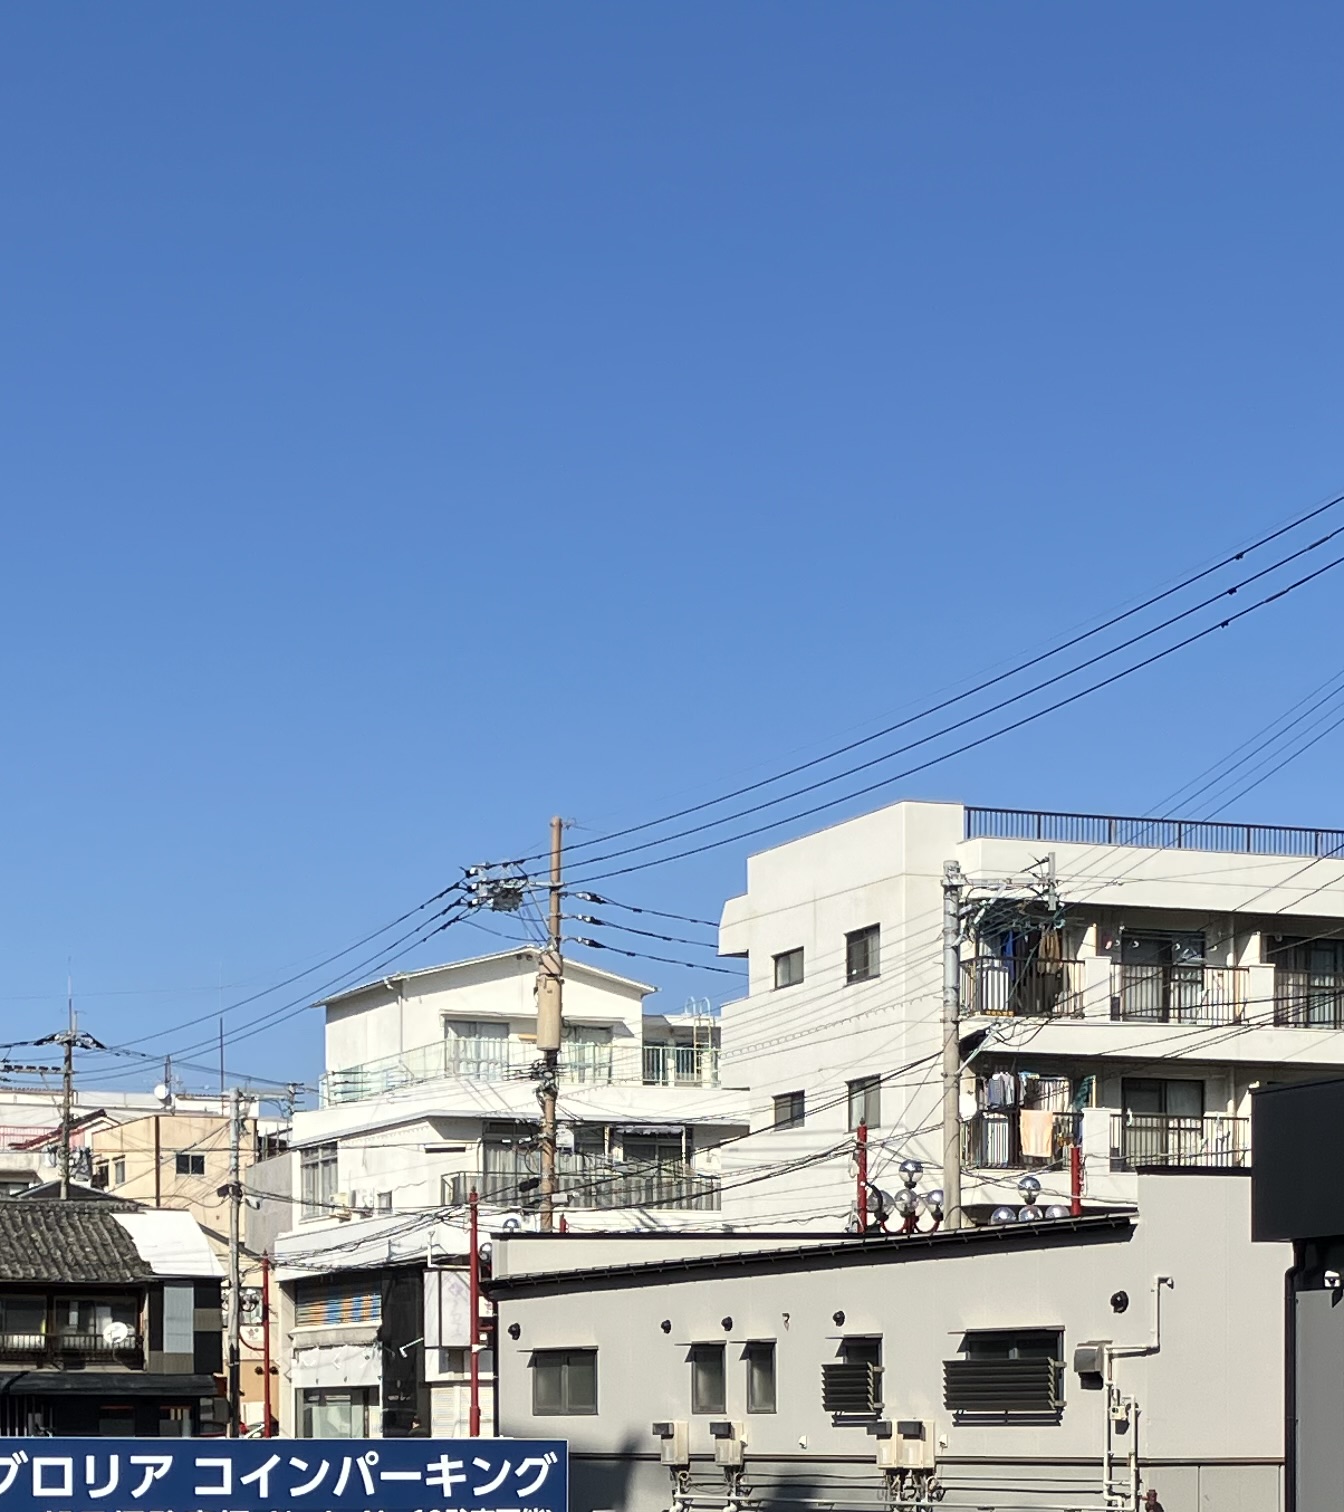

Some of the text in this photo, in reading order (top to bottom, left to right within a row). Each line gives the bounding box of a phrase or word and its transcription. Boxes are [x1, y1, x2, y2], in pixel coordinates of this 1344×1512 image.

[195, 1451, 558, 1498] コインパーキング
